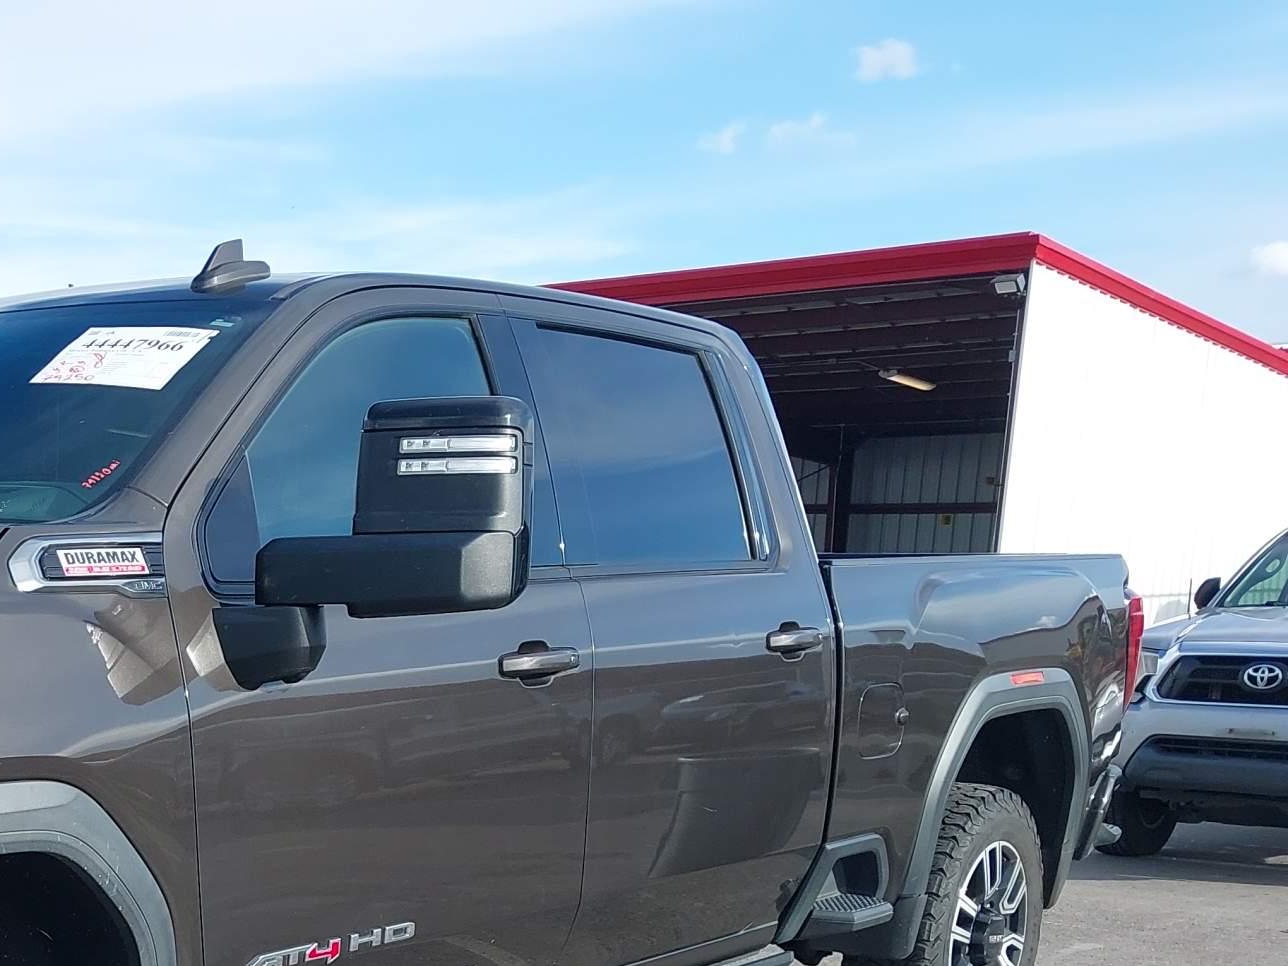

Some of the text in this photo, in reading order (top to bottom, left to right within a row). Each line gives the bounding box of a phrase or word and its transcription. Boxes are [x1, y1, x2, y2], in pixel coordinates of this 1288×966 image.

[82, 339, 187, 351] 44447966
[63, 551, 139, 565] DURAMAX
[348, 921, 416, 952] HD
